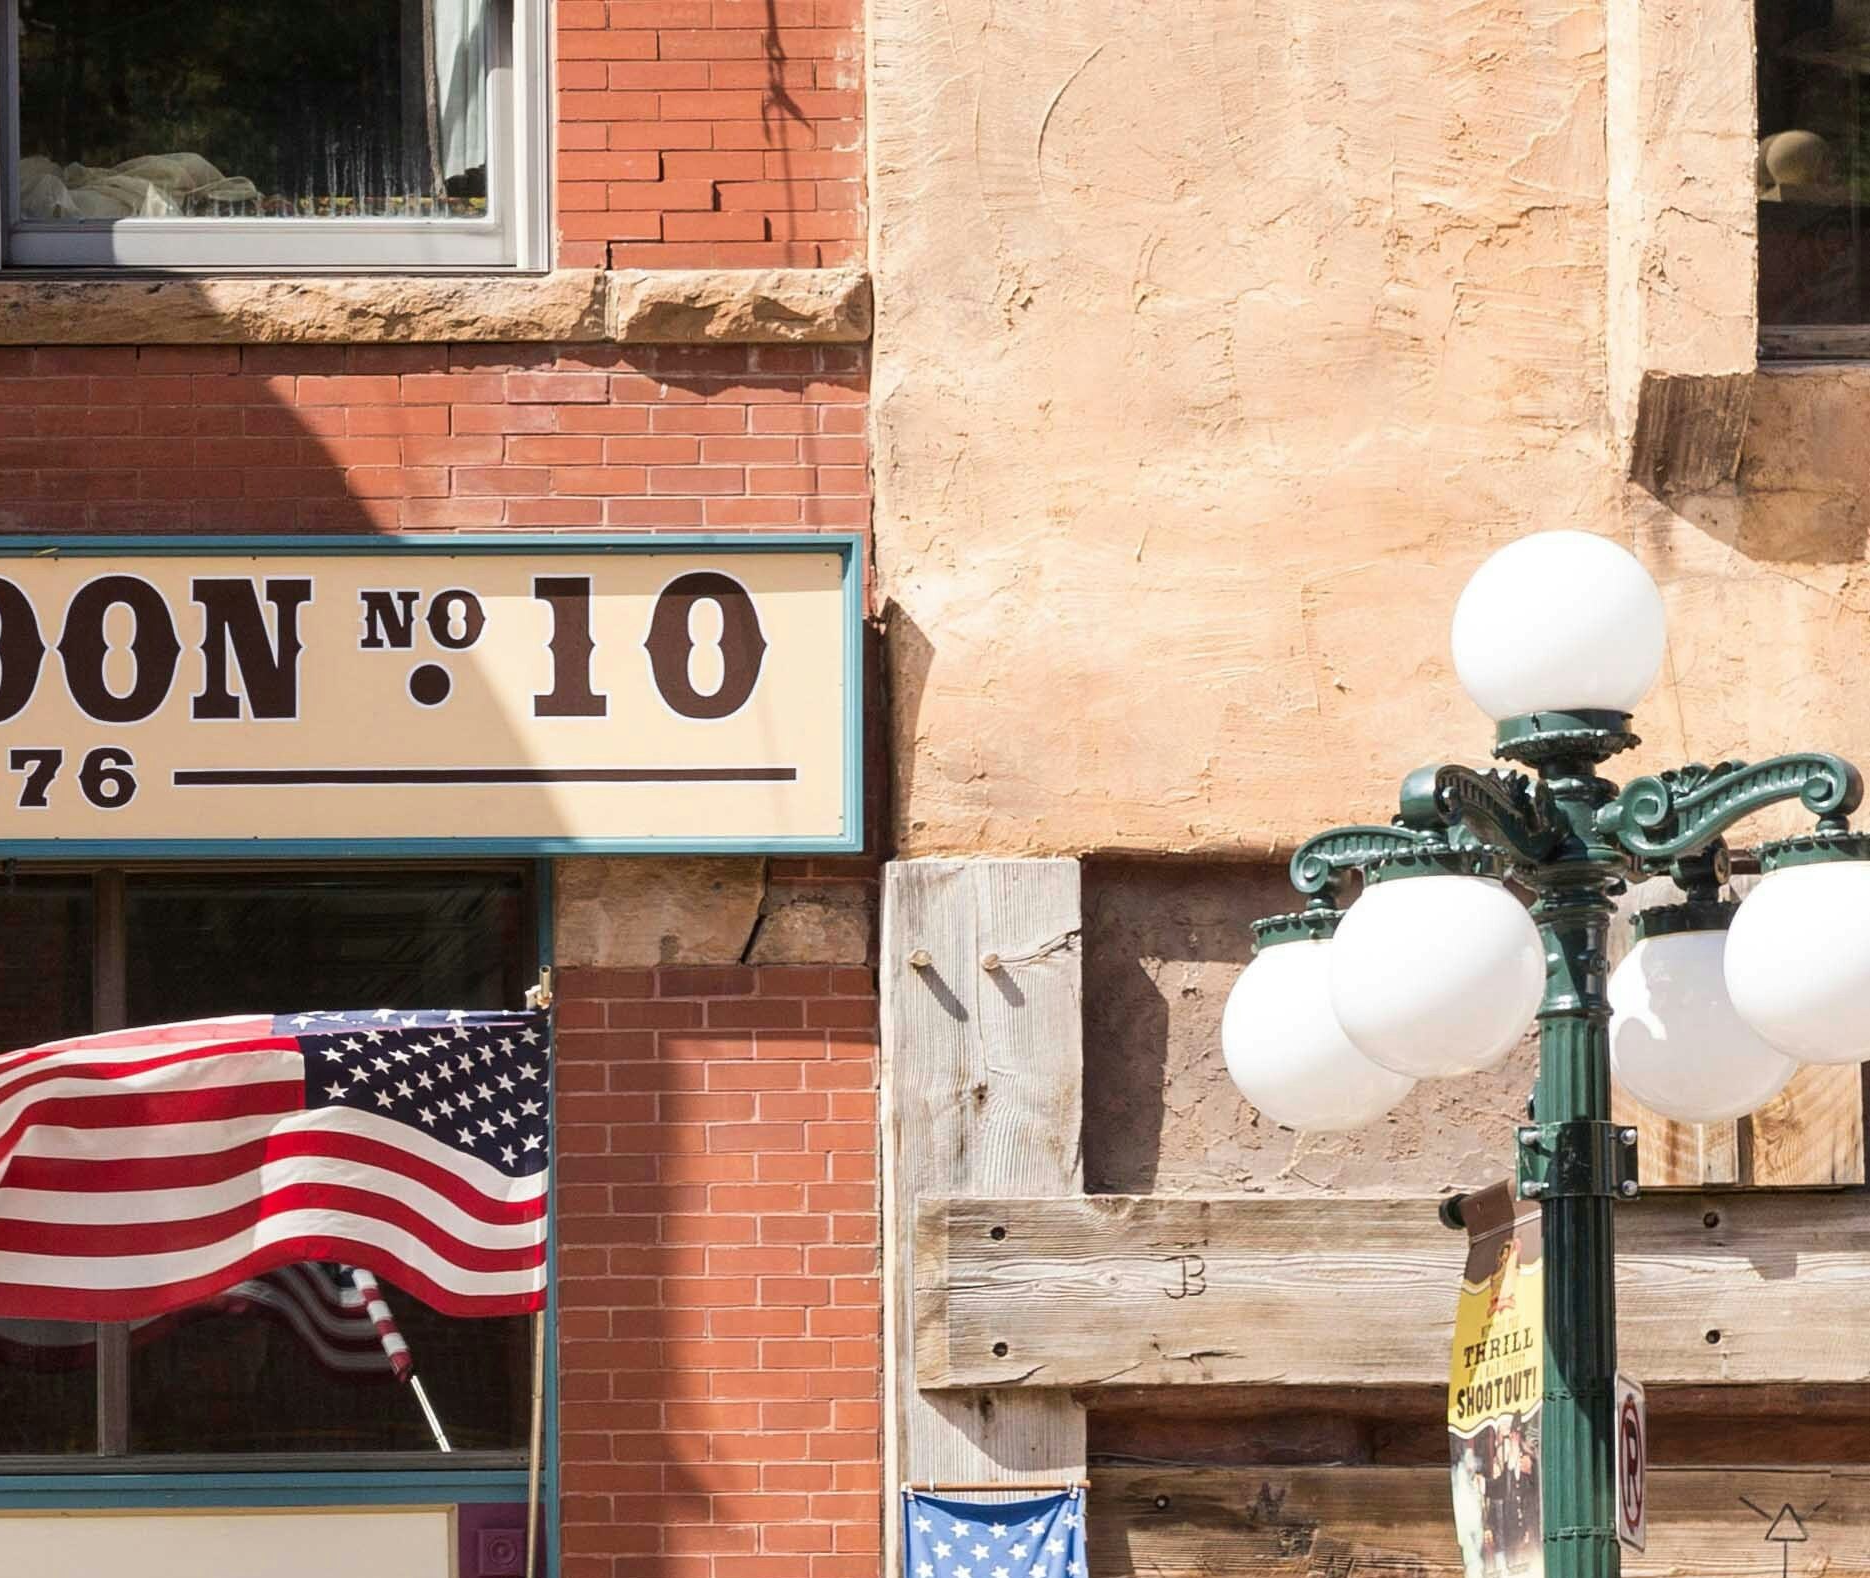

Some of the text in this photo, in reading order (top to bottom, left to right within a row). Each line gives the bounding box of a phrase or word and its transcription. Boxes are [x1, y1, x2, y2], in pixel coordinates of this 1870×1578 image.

[360, 588, 486, 650] NO
[533, 572, 767, 719] 10
[1463, 1327, 1533, 1368] THRILL
[1457, 1366, 1537, 1419] SHOOTOUT!
